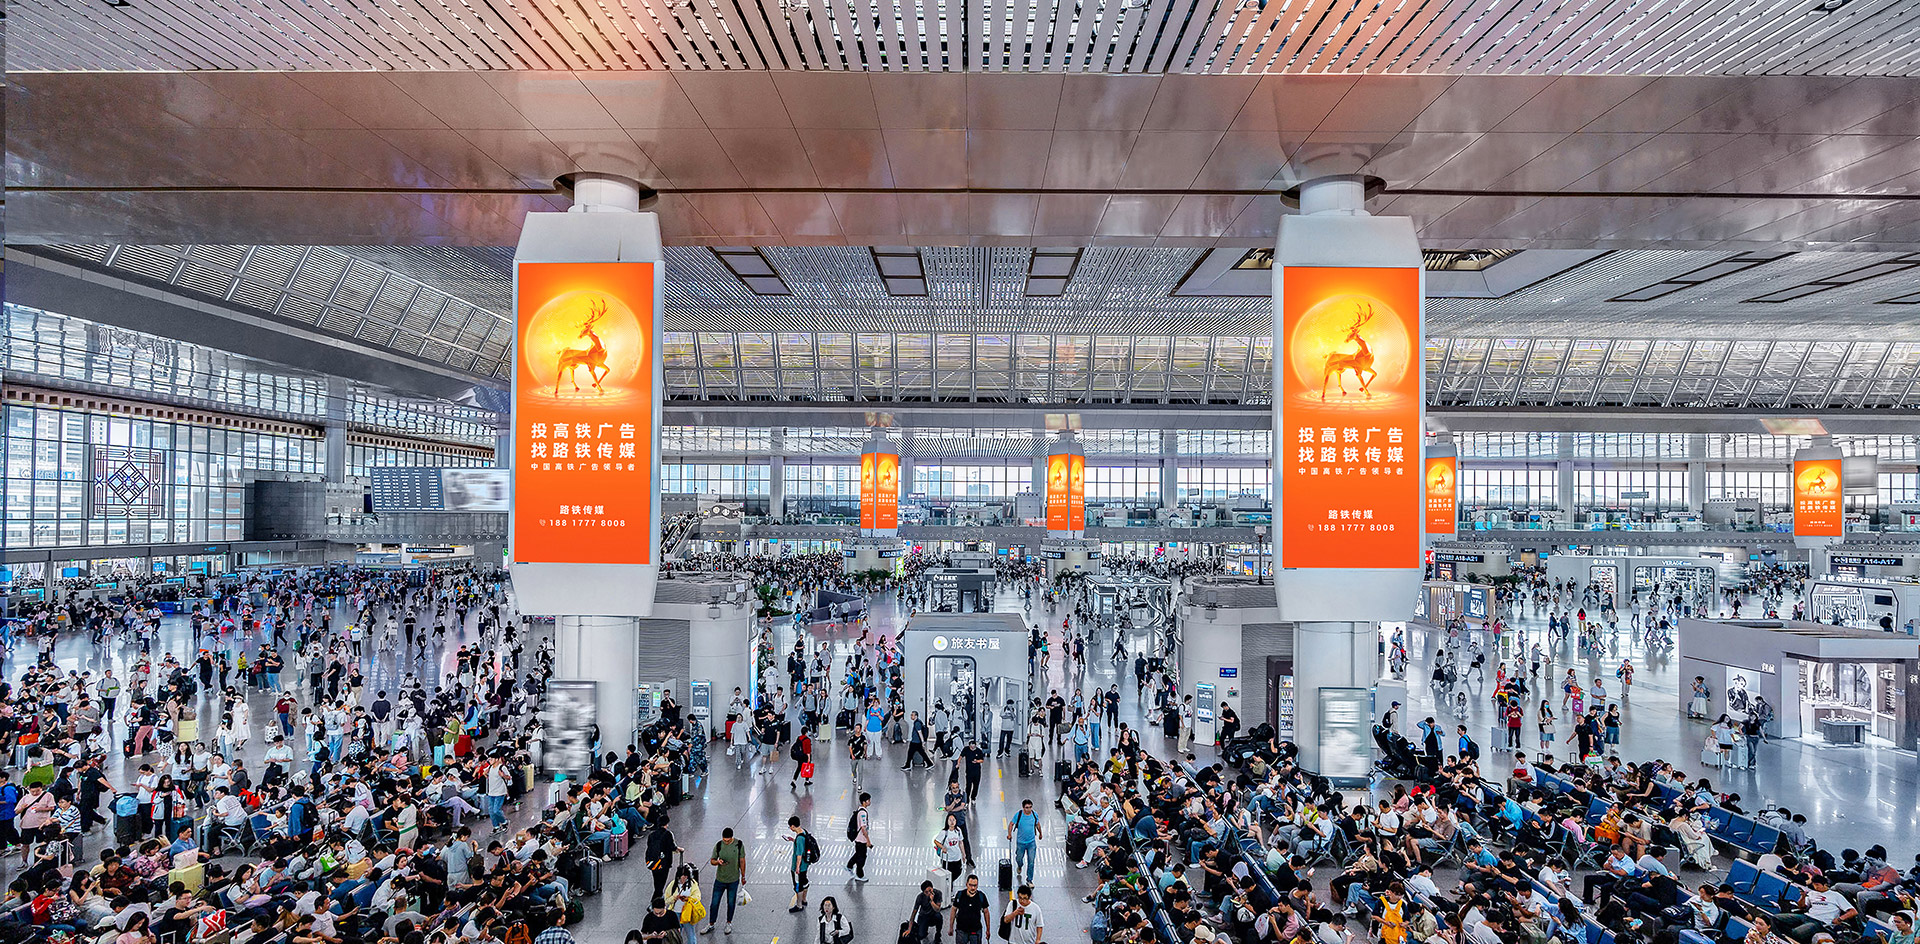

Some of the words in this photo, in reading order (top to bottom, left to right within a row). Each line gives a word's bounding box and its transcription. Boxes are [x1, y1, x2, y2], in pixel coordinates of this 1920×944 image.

[531, 423, 636, 439] 投高铁广告
[1298, 427, 1404, 444] 投高铁广告
[531, 442, 636, 459] 找路铁传媒
[1298, 446, 1404, 463] 找路铁传媒
[531, 463, 636, 471] 中国高铁广告领导者
[1298, 467, 1404, 476] 中国高铁广告领导者
[559, 504, 605, 515] 路铁传媒
[1328, 509, 1374, 520] 路铁传媒
[549, 519, 567, 527] 188
[572, 519, 596, 527] 1777
[600, 519, 626, 527] 8008
[1318, 524, 1336, 532] 188
[1341, 524, 1365, 532] 1777
[1370, 524, 1395, 532] 8008
[951, 637, 1000, 649] 旅友书屋
